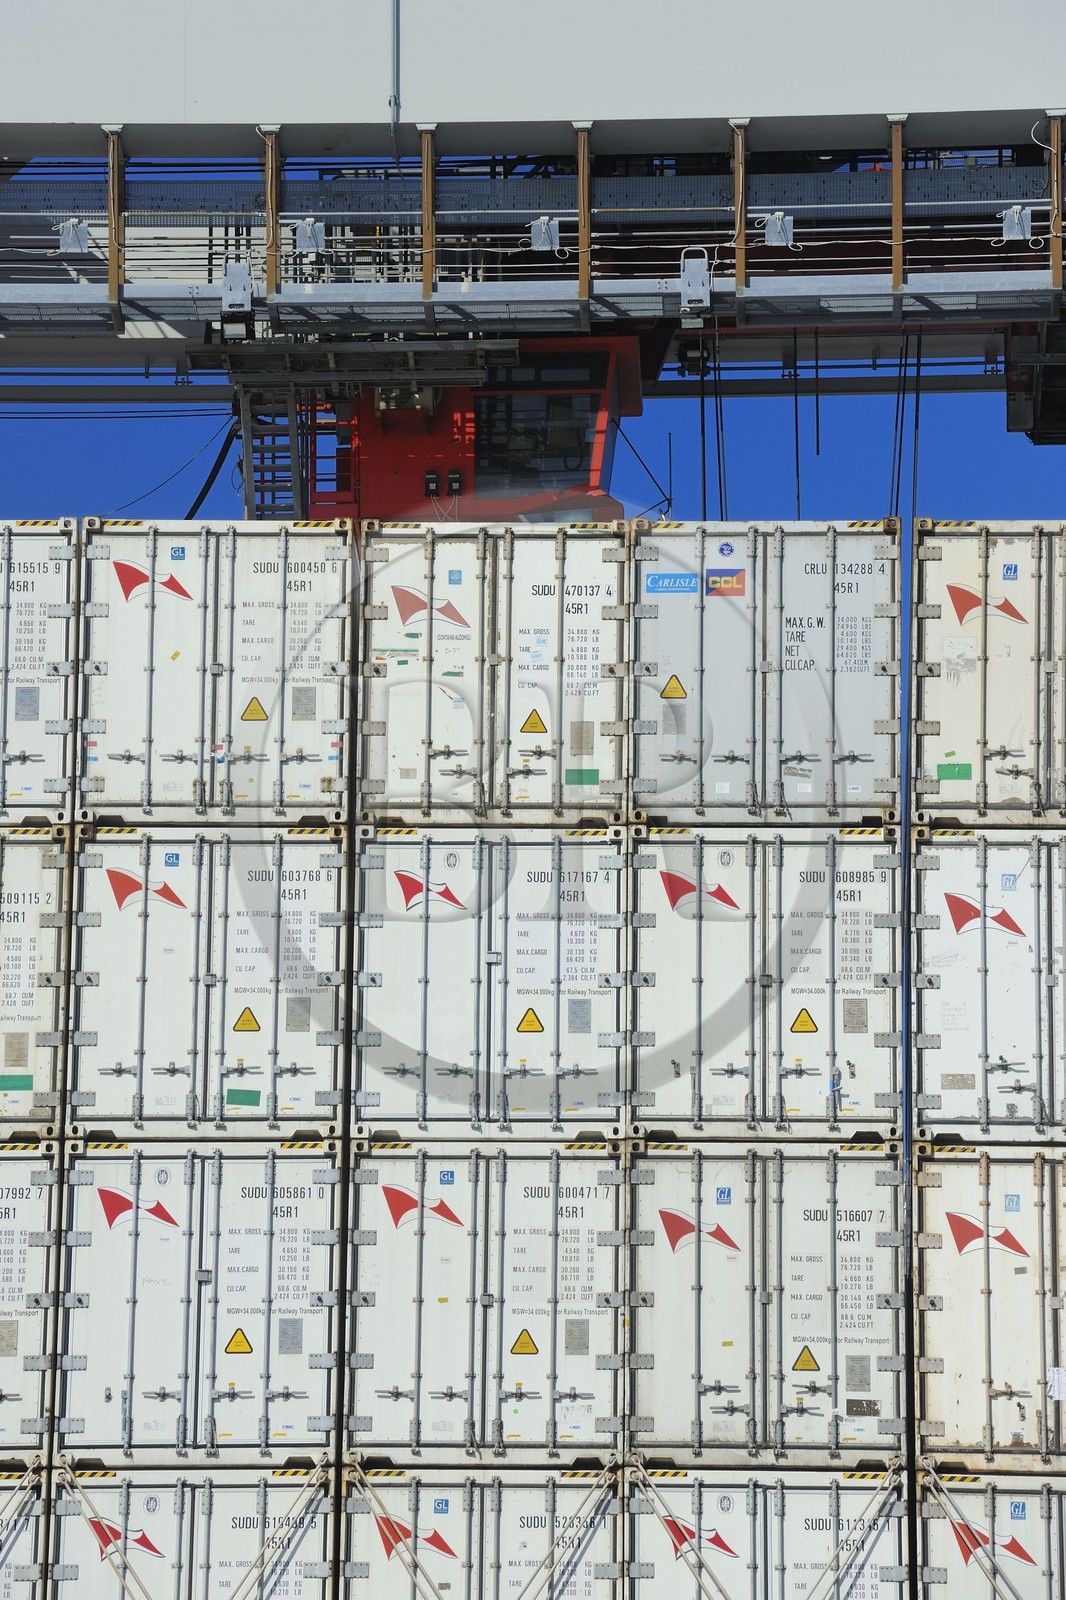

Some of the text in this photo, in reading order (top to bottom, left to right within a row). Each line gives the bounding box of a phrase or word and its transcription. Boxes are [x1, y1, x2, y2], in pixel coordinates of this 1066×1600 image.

[10, 562, 61, 574] 615515 9
[252, 562, 337, 574] SUDU 600450 6
[804, 563, 885, 574] CRLU 134288 4
[1004, 565, 1017, 576] GL
[9, 581, 35, 592] 45R1
[287, 580, 313, 592] 45R1
[647, 575, 698, 587] CARLISLE
[708, 576, 743, 588] CCL
[531, 584, 613, 596] SUDU 470137 4
[834, 582, 859, 594] 45R1
[565, 603, 588, 614] 45R1
[785, 631, 806, 642] TARE
[785, 645, 800, 656] NET
[291, 676, 336, 685] Railway Transport
[166, 854, 178, 862] GL
[247, 870, 332, 882] SUDU 603768 6
[526, 871, 610, 883] SUDU 617167 4
[799, 871, 887, 883] SUDU 608985 9
[0, 892, 52, 904] 509115 2
[281, 889, 307, 900] 45R1
[560, 890, 585, 902] 45R1
[836, 890, 862, 901] 45R1
[0, 911, 26, 923] 45R1
[284, 987, 304, 995] Railway
[567, 988, 612, 997] Railway Transport
[842, 988, 886, 996] Railway Transport
[441, 1172, 453, 1180] GL
[0, 1187, 43, 1199] 07992 7
[241, 1187, 268, 1199] SUDU
[273, 1187, 312, 1199] 605861
[523, 1187, 610, 1199] SUDU 600471 7
[718, 1189, 730, 1200] GL
[0, 1208, 16, 1219] 5R1
[272, 1206, 298, 1218] 45R1
[558, 1206, 584, 1218] 45R1
[803, 1210, 885, 1222] SUDU 516607 7
[836, 1230, 861, 1242] 45R1
[563, 1308, 608, 1317] Railway Transport
[843, 1337, 864, 1345] Railway
[1011, 1502, 1025, 1514] GL
[231, 1516, 259, 1529] SUDU
[310, 1516, 317, 1529] 5
[519, 1516, 547, 1529] SUDU
[603, 1516, 607, 1528] 1
[804, 1518, 832, 1530] SUDU
[886, 1519, 890, 1531] 1
